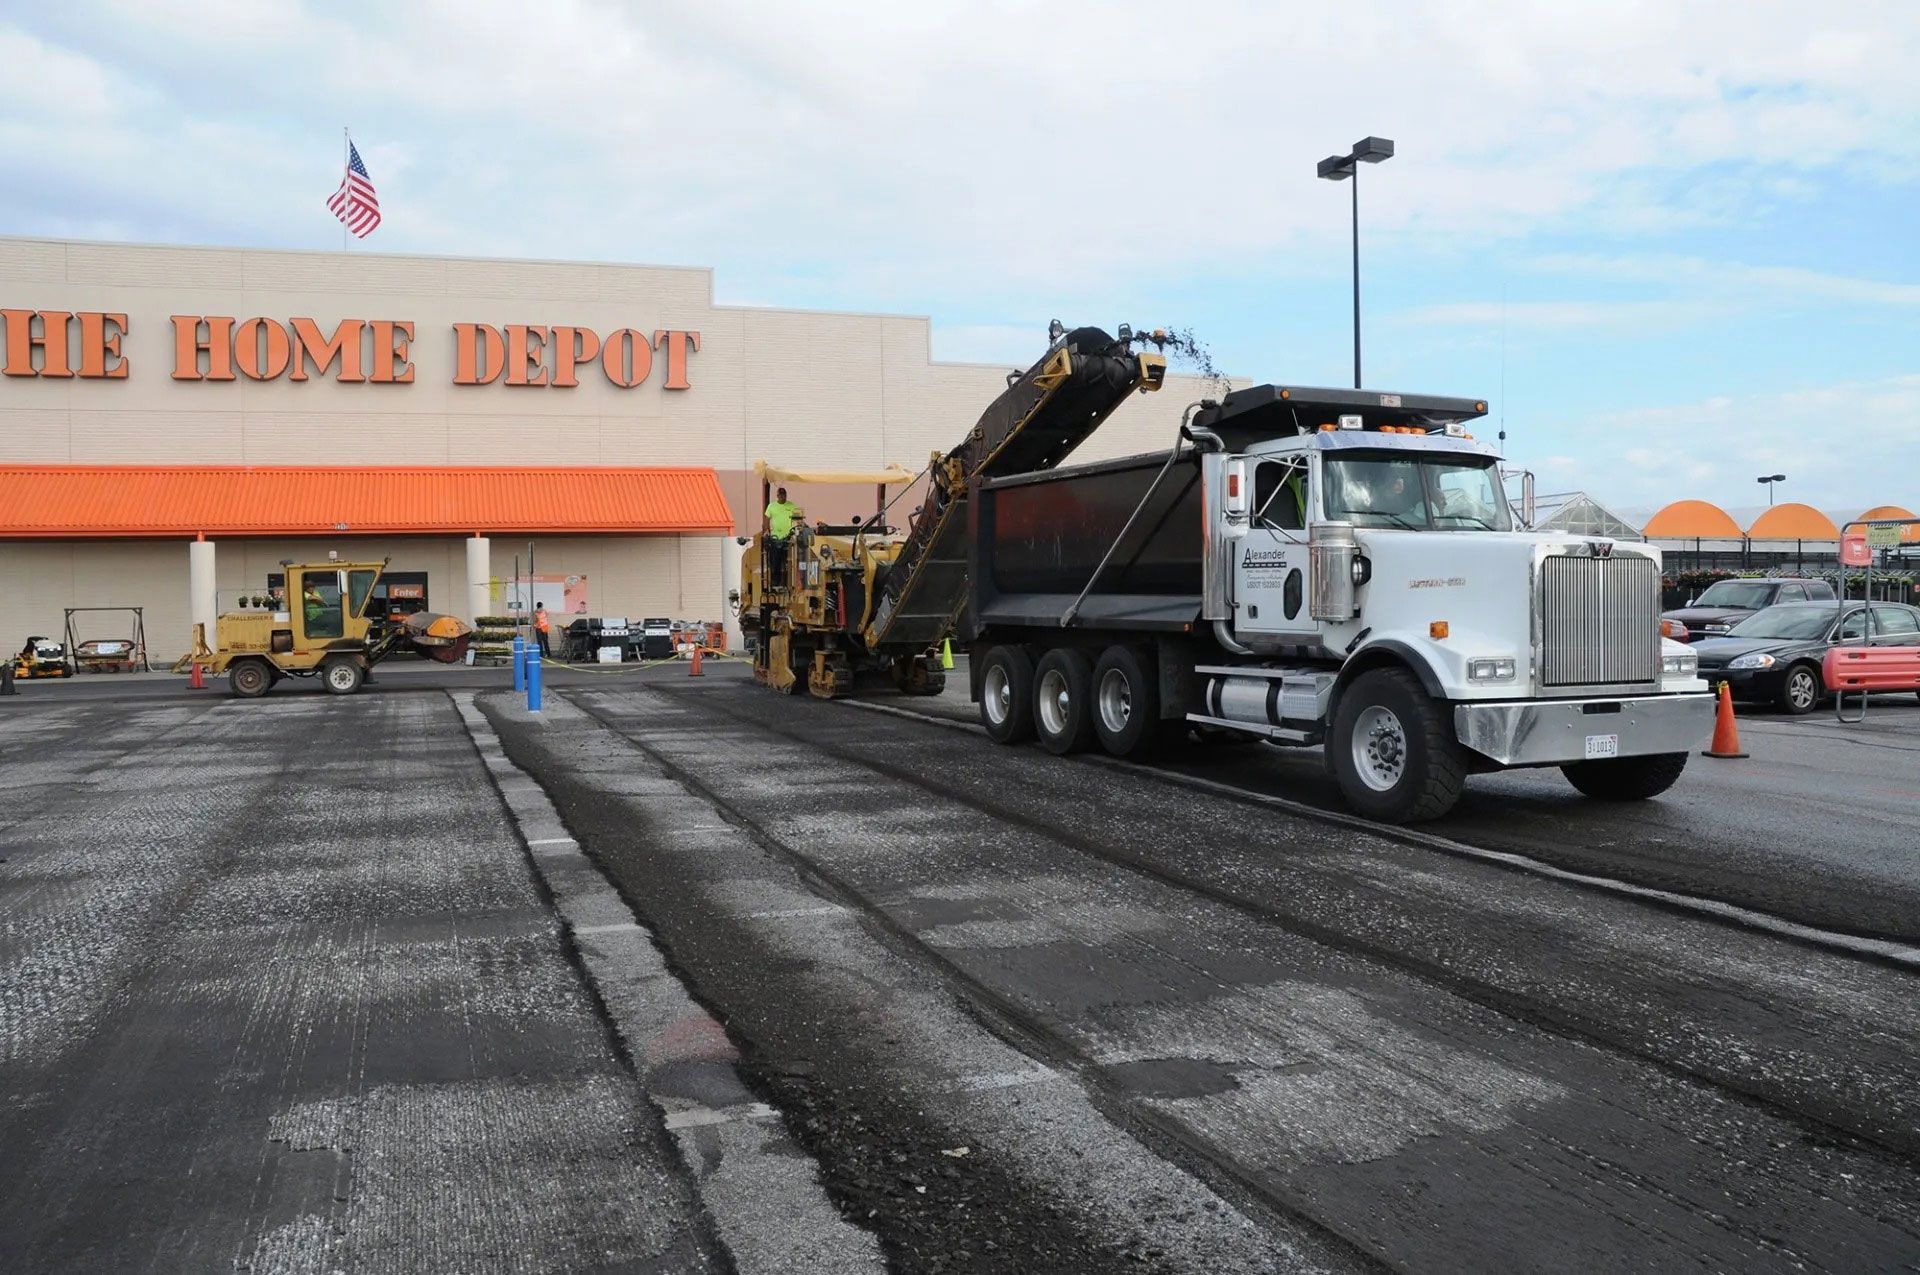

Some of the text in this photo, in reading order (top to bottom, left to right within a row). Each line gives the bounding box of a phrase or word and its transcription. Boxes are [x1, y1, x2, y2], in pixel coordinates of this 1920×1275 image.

[0, 308, 701, 391] HE HOME DEPOT
[1243, 547, 1286, 563] Alexander
[394, 588, 419, 597] Enter
